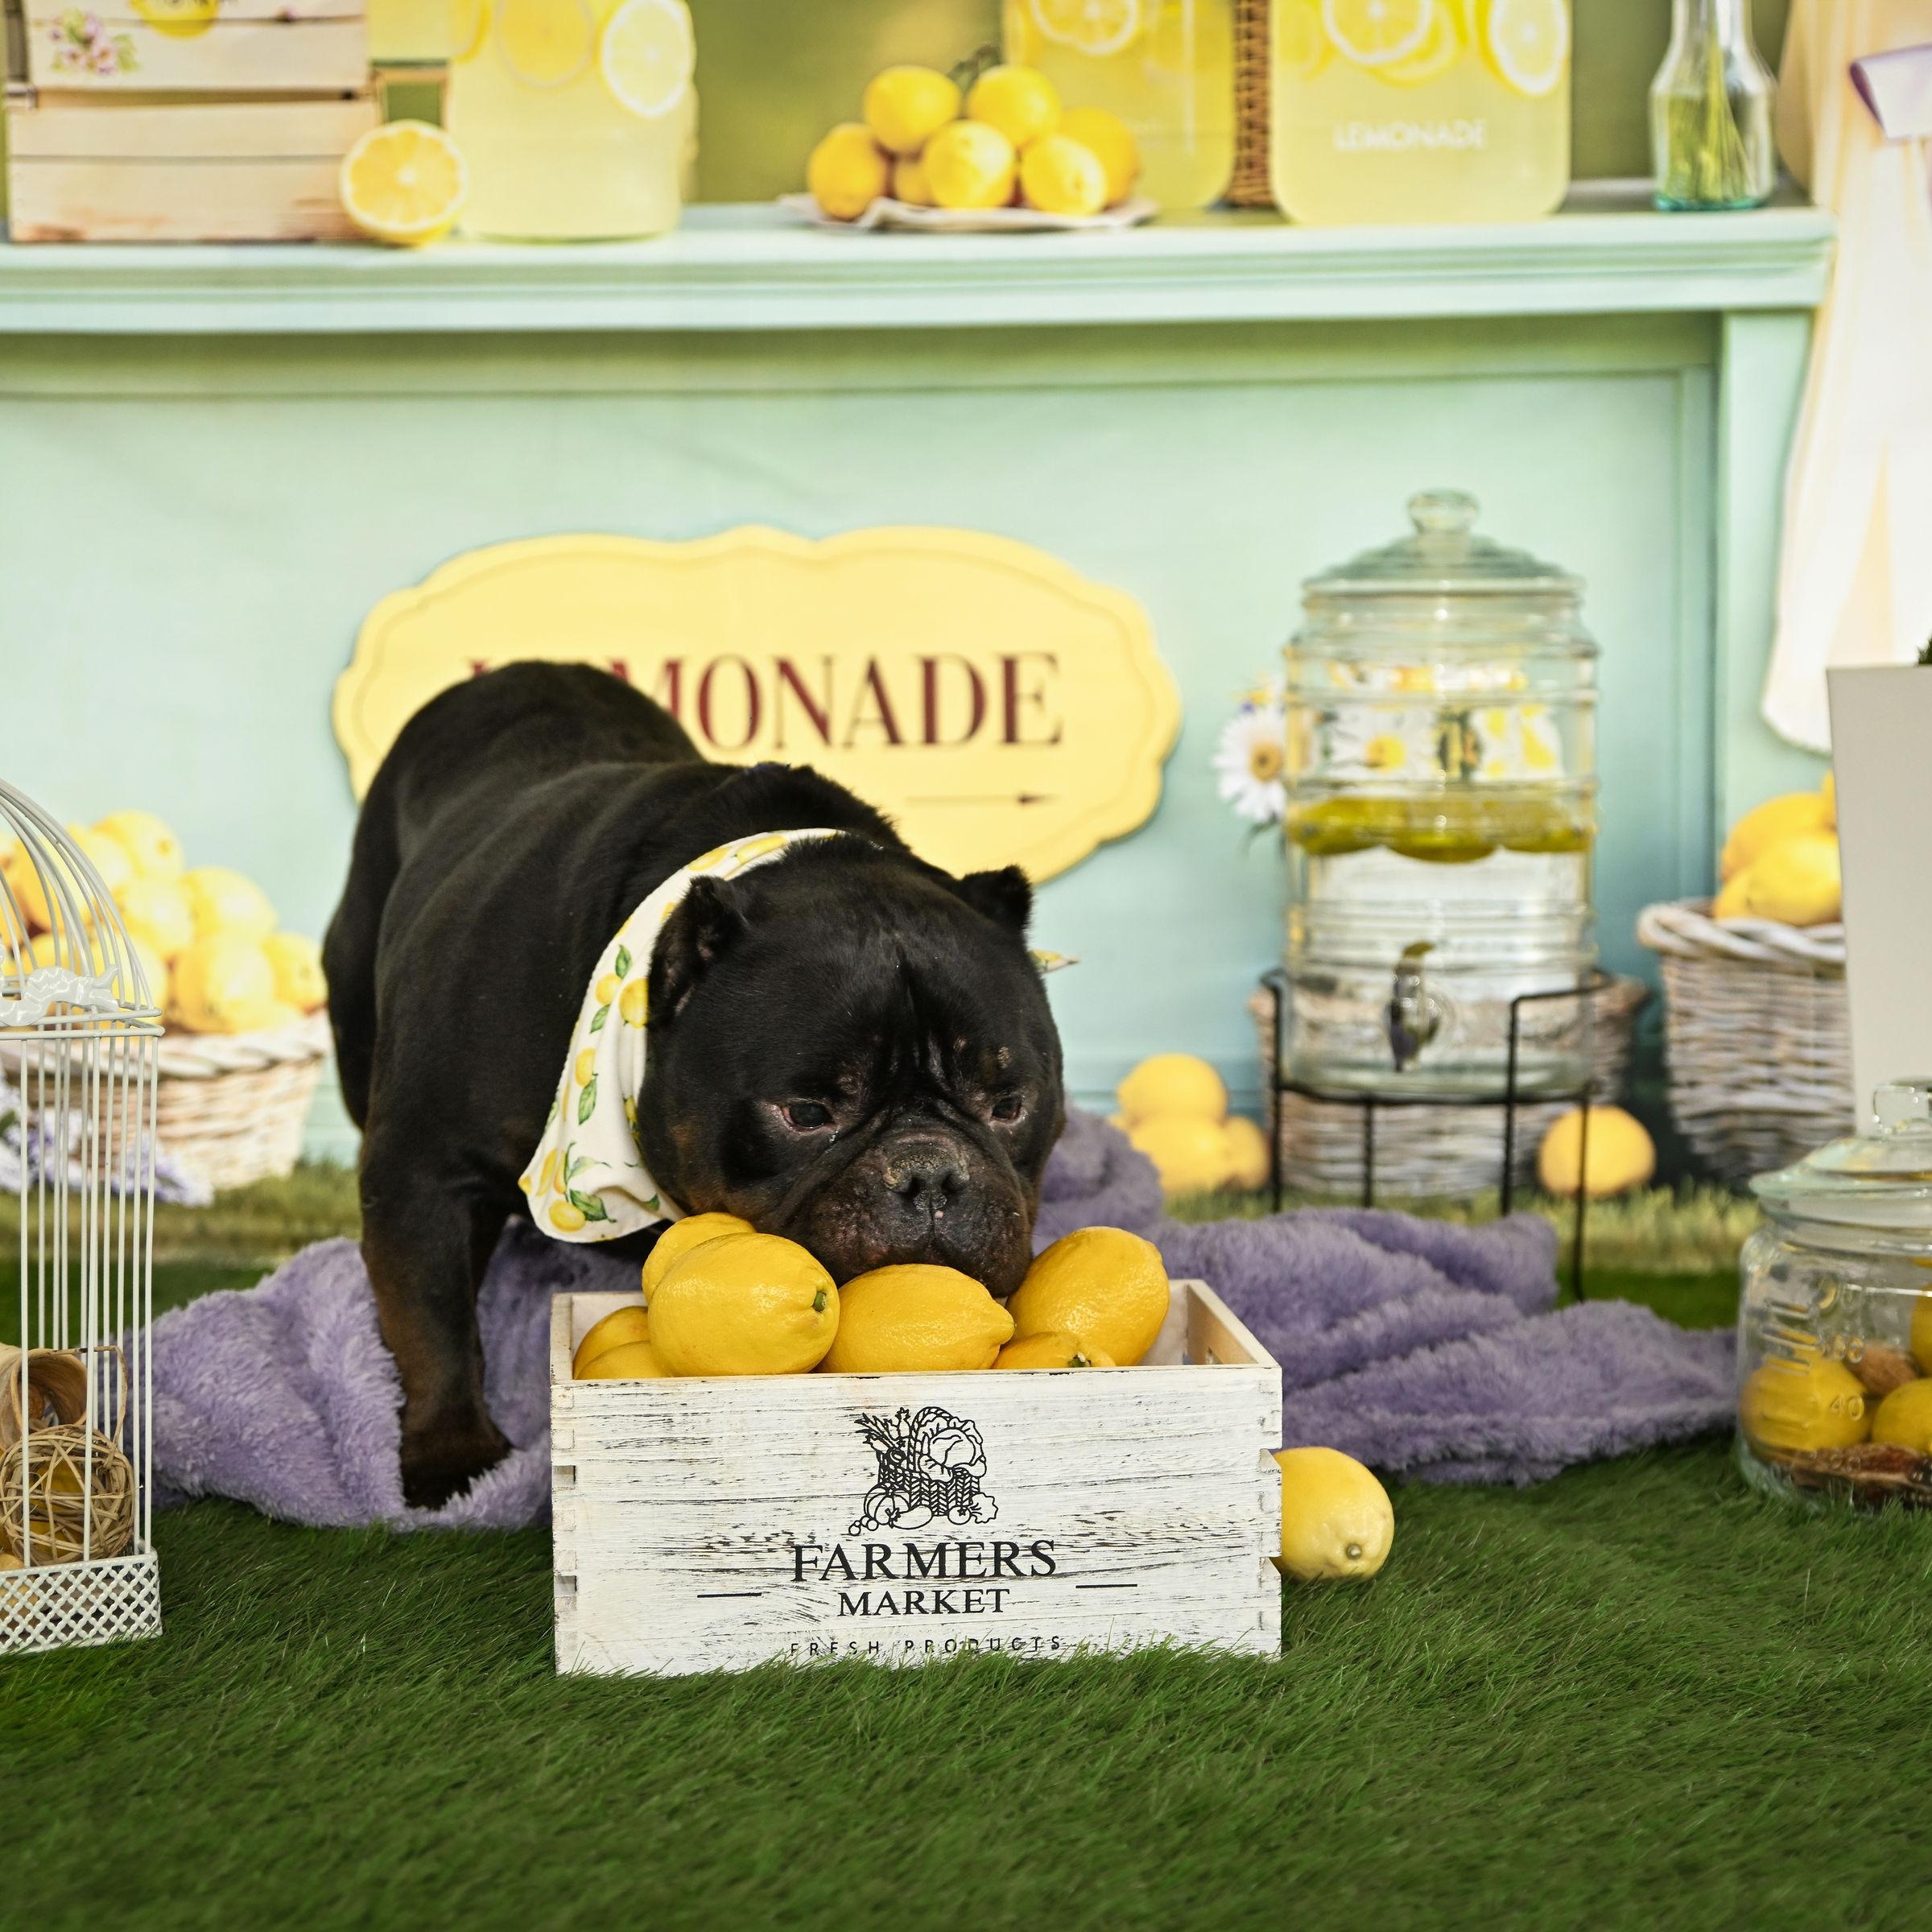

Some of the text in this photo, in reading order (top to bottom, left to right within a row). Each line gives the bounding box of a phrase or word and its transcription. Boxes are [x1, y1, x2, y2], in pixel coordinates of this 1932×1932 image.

[469, 653, 1063, 750] ONADE
[791, 1539, 1057, 1582] FARMERS
[837, 1588, 1010, 1616] MARKET
[791, 1641, 880, 1656] FRESH
